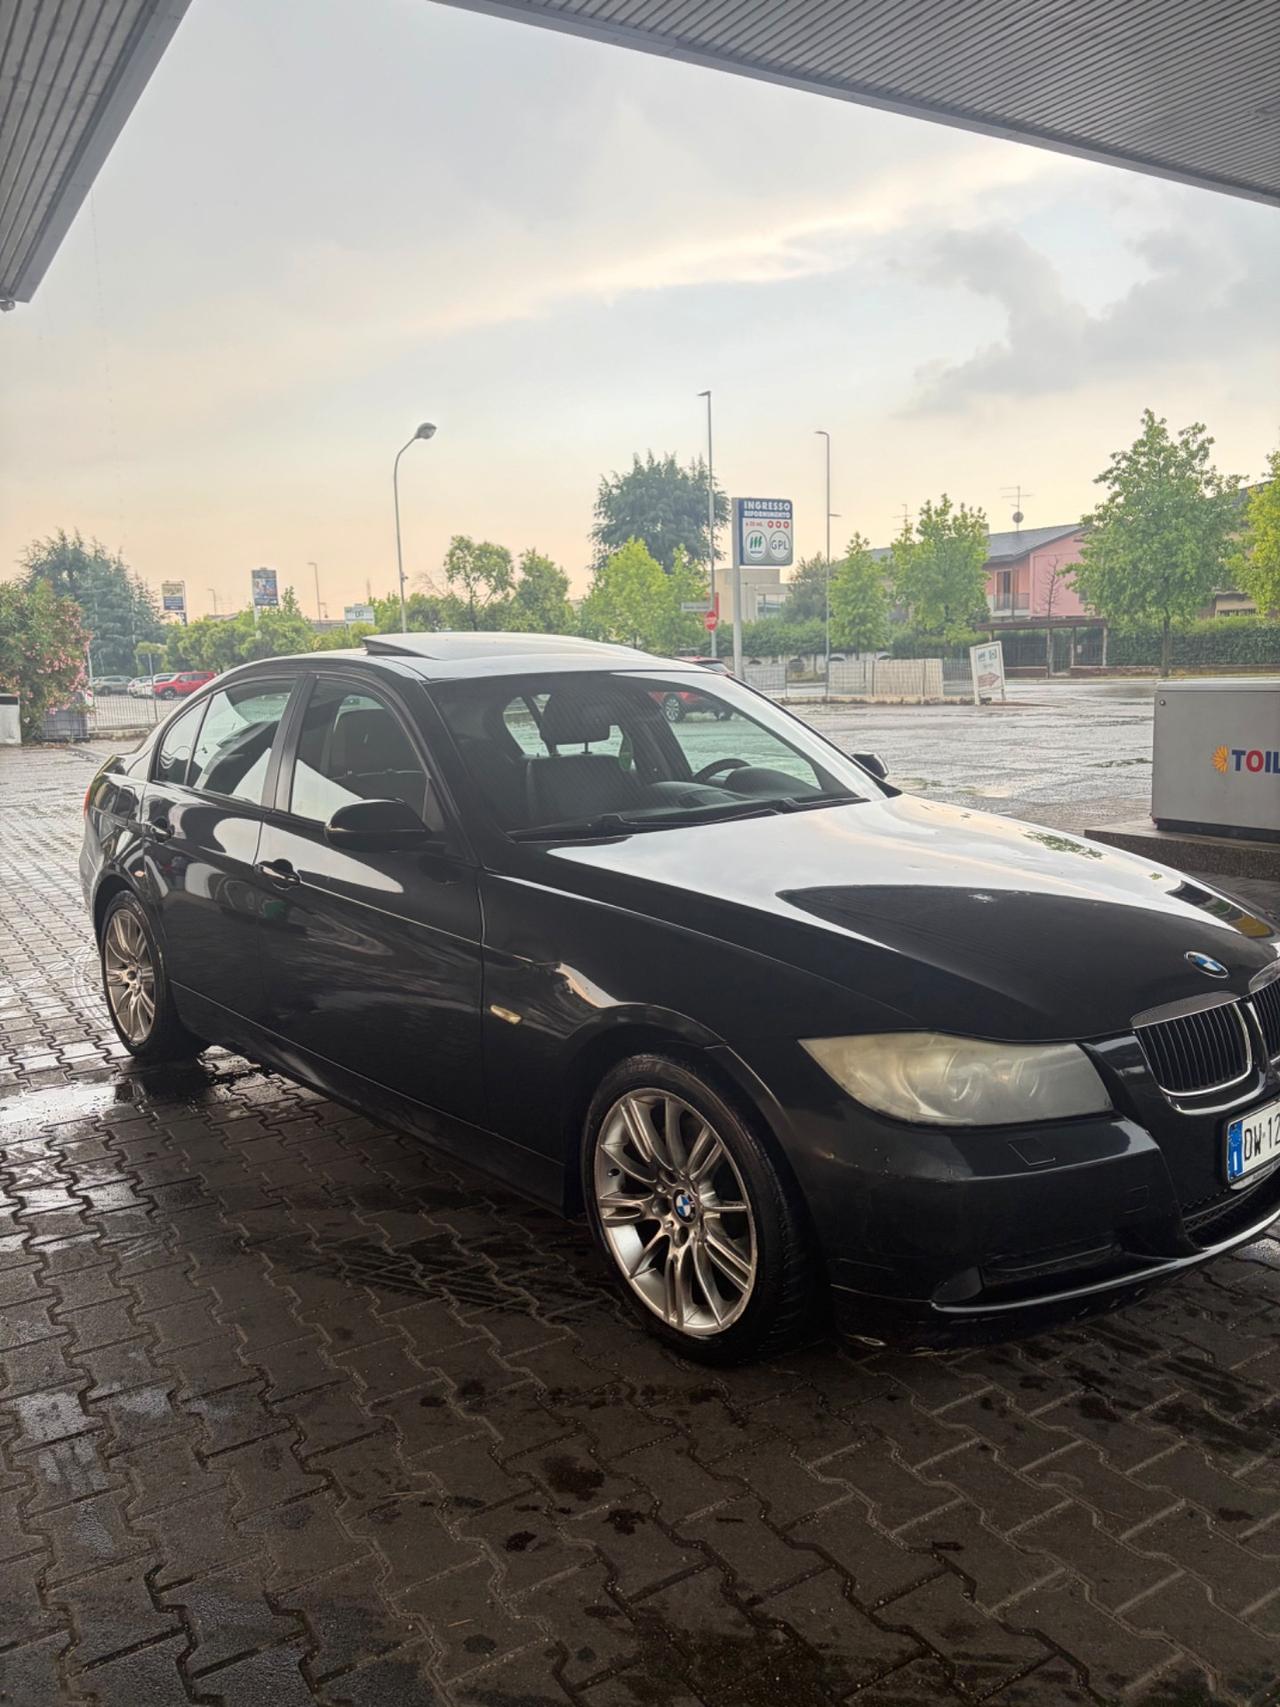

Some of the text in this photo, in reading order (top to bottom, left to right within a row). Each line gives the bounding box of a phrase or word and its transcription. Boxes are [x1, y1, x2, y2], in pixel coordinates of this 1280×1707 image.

[743, 500, 791, 511] INGRESSO
[771, 539, 789, 550] GPL
[1231, 749, 1280, 774] TOIL
[1244, 1123, 1262, 1162] DW
